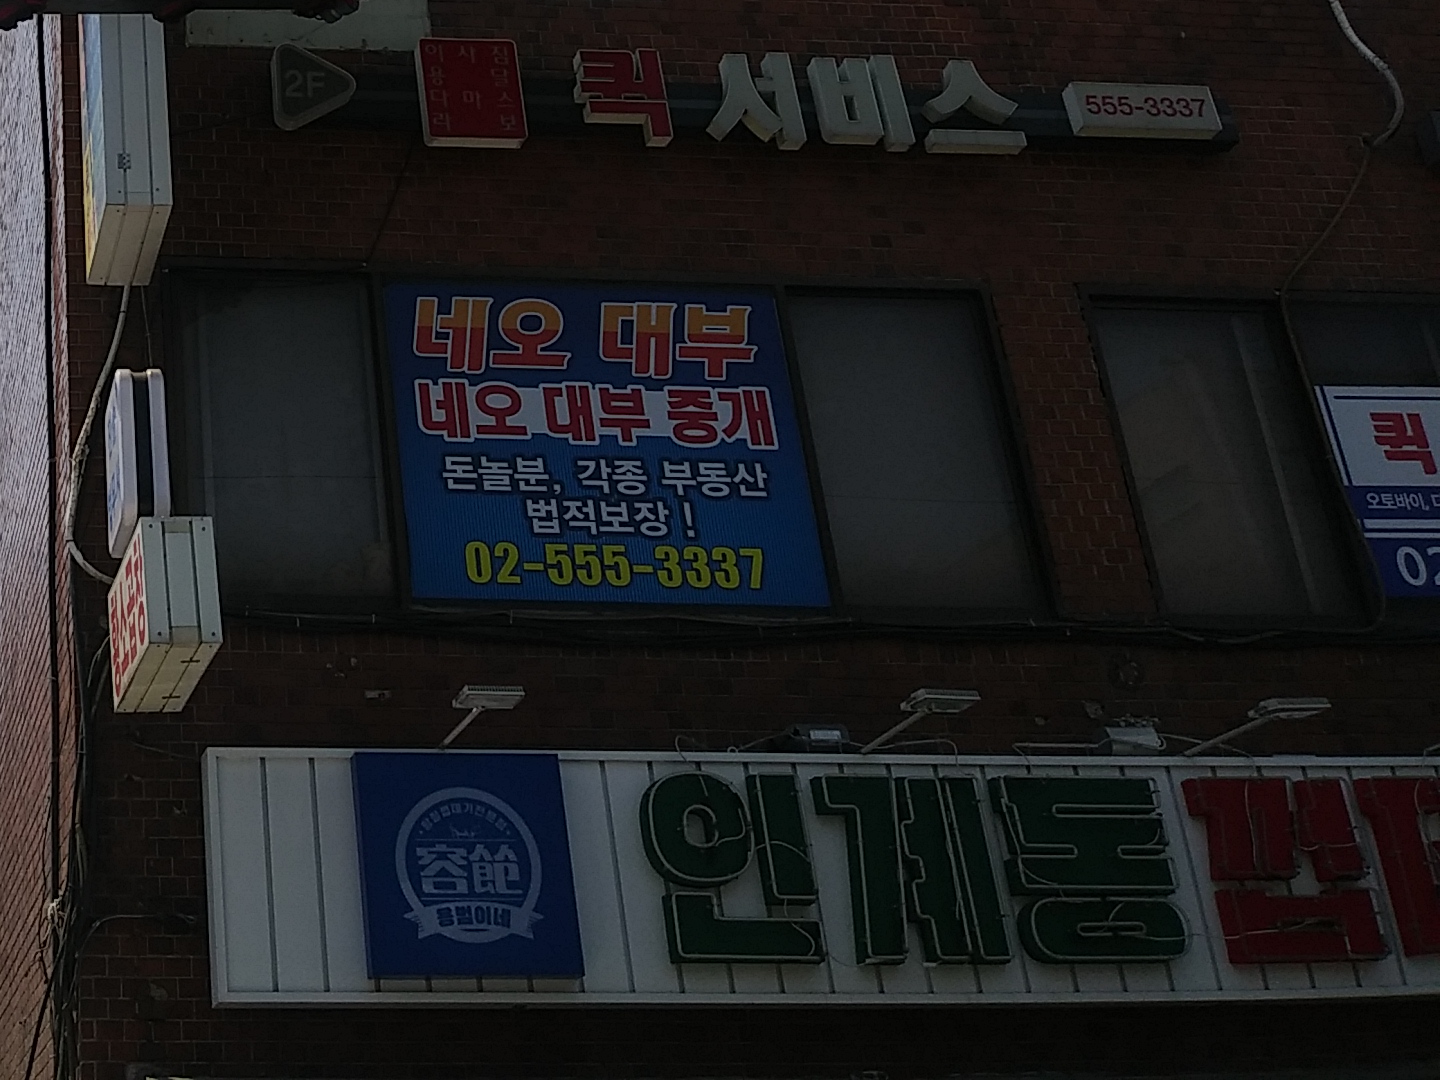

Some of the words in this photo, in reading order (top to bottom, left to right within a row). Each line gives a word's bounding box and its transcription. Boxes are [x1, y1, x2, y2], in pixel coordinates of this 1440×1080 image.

[284, 69, 325, 98] 2F
[706, 50, 1028, 155] 서비스
[1085, 94, 1206, 119] 555-3337
[413, 296, 572, 374] 네오
[599, 301, 759, 380] 대부
[417, 381, 528, 440] 네오
[542, 384, 651, 444] 대부
[666, 388, 776, 449] 중개
[1370, 413, 1437, 474] 퀵
[576, 458, 648, 496] 각종
[661, 461, 769, 498] 부동산
[464, 541, 763, 590] 02-555-3337
